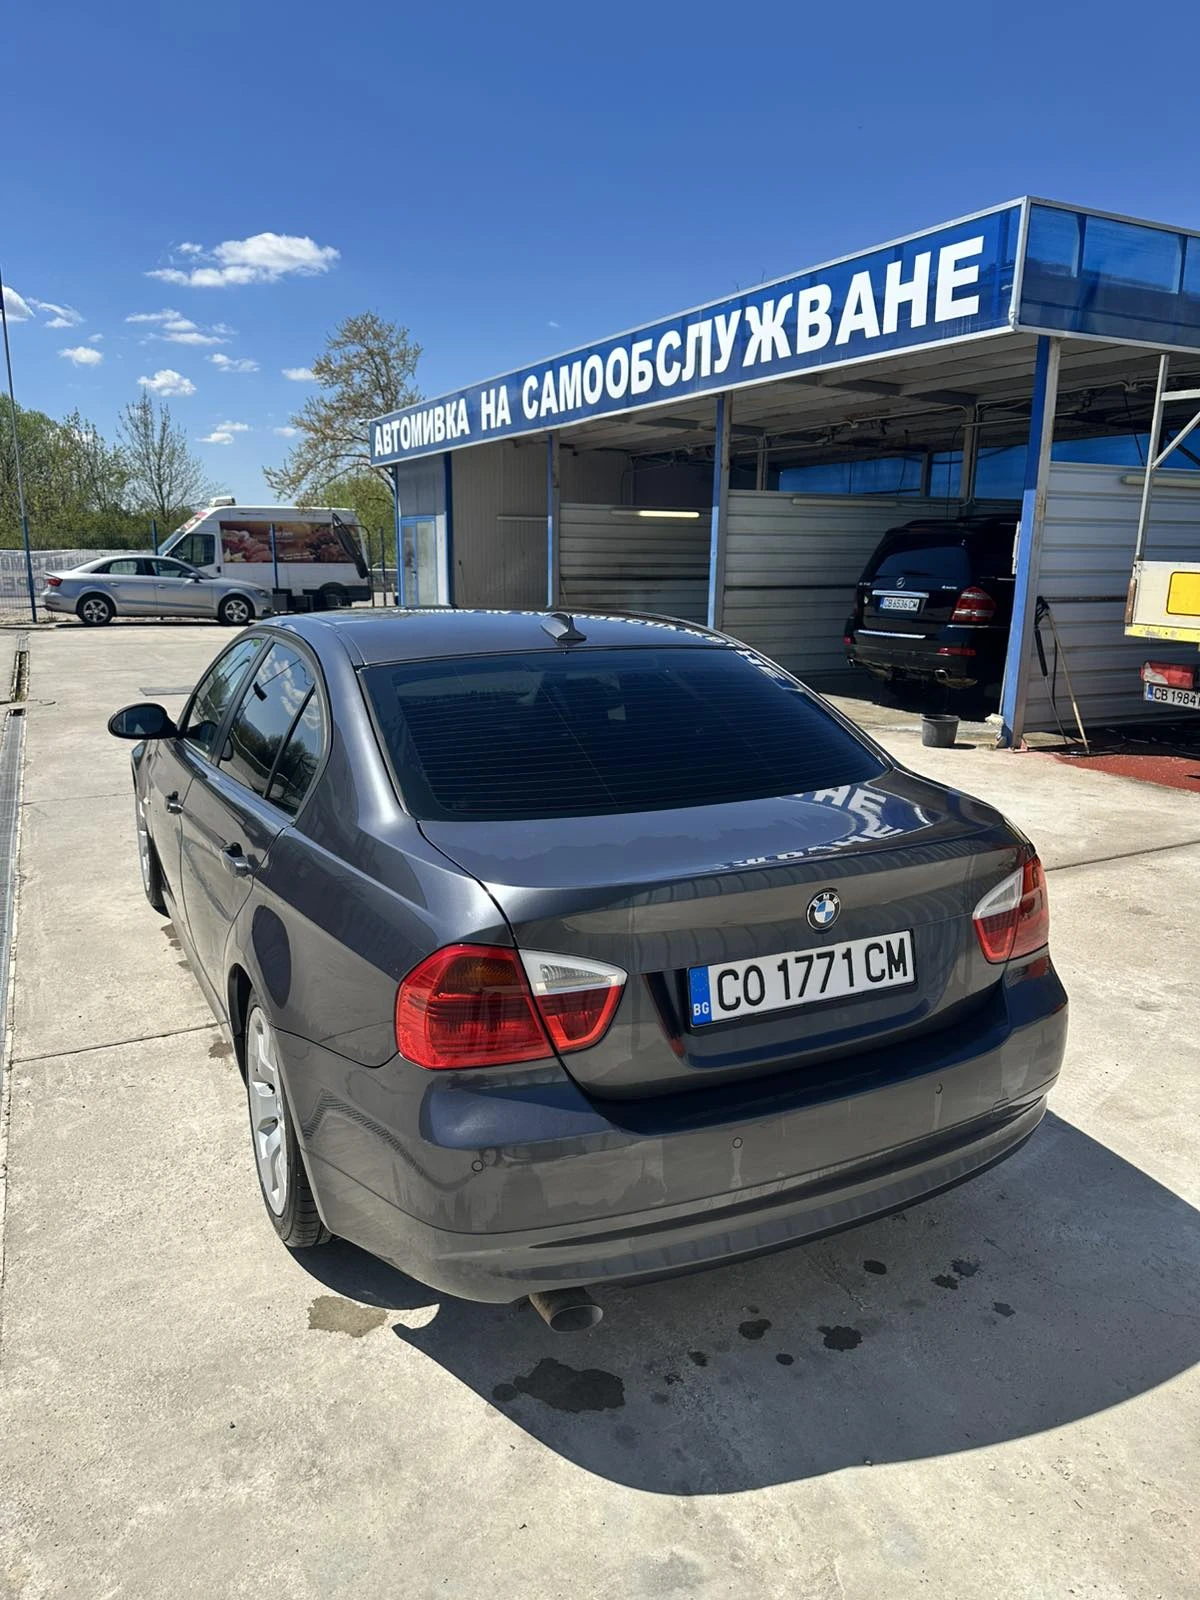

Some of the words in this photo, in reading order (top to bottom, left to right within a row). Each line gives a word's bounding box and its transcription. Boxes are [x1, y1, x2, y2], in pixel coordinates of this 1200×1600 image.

[374, 397, 471, 457] АВТОМИВКА
[480, 385, 511, 431] НА
[522, 236, 985, 420] САМООБСЛУЖВАНЕ
[1154, 688, 1168, 701] CB
[1172, 690, 1196, 706] 1984
[717, 965, 765, 1011] CO
[777, 947, 855, 1000] 1771
[865, 938, 908, 983] CM
[693, 1002, 709, 1016] BG
